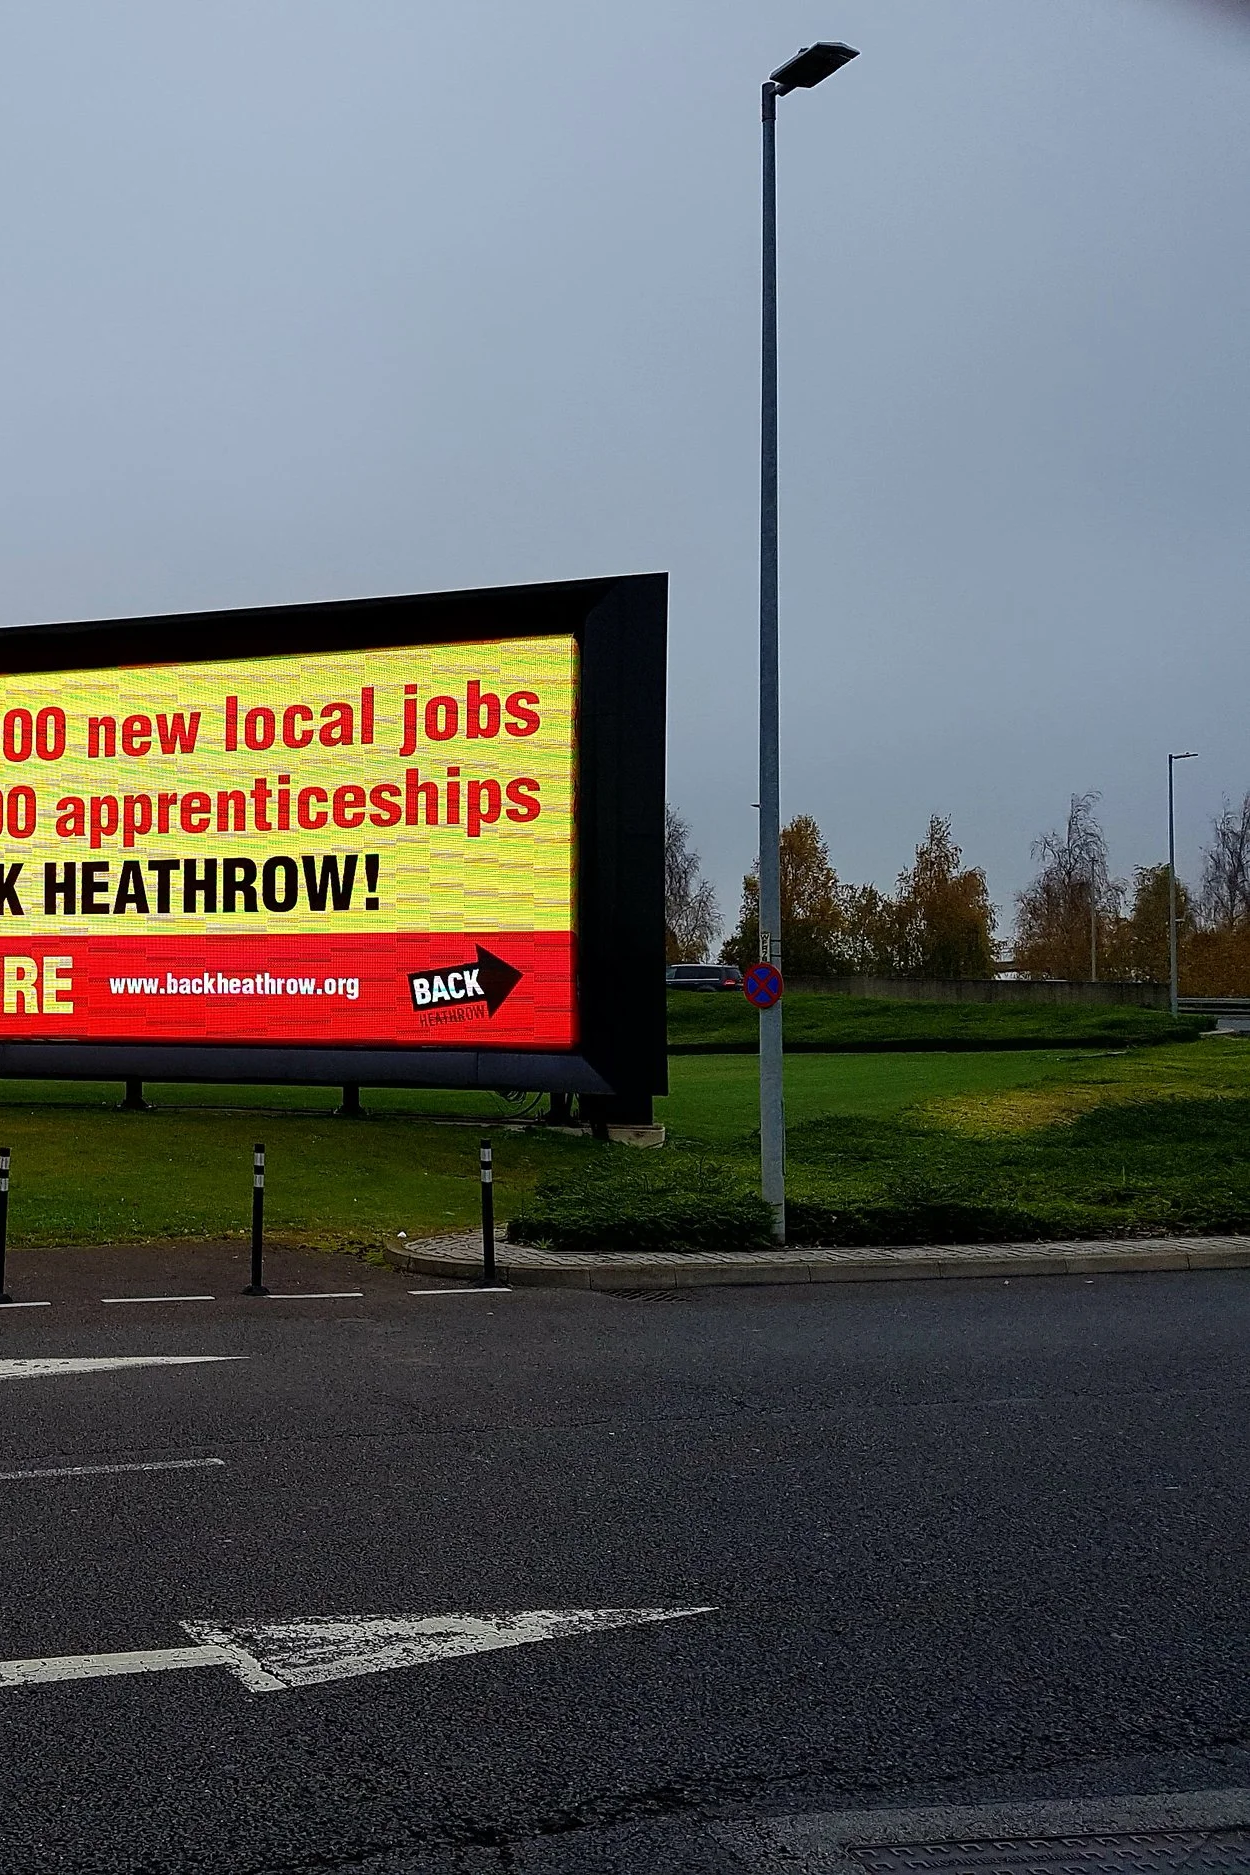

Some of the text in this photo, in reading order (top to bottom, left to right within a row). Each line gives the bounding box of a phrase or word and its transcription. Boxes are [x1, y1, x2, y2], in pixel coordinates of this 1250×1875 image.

[88, 712, 200, 758] new
[226, 687, 374, 750] local
[399, 680, 540, 755] jobs
[56, 767, 540, 849] apprenticeships
[45, 854, 379, 914] HEATHROW!
[110, 973, 359, 999] www.backheathrow.org
[413, 969, 484, 1004] BACK
[420, 1004, 485, 1027] HEATHROW
